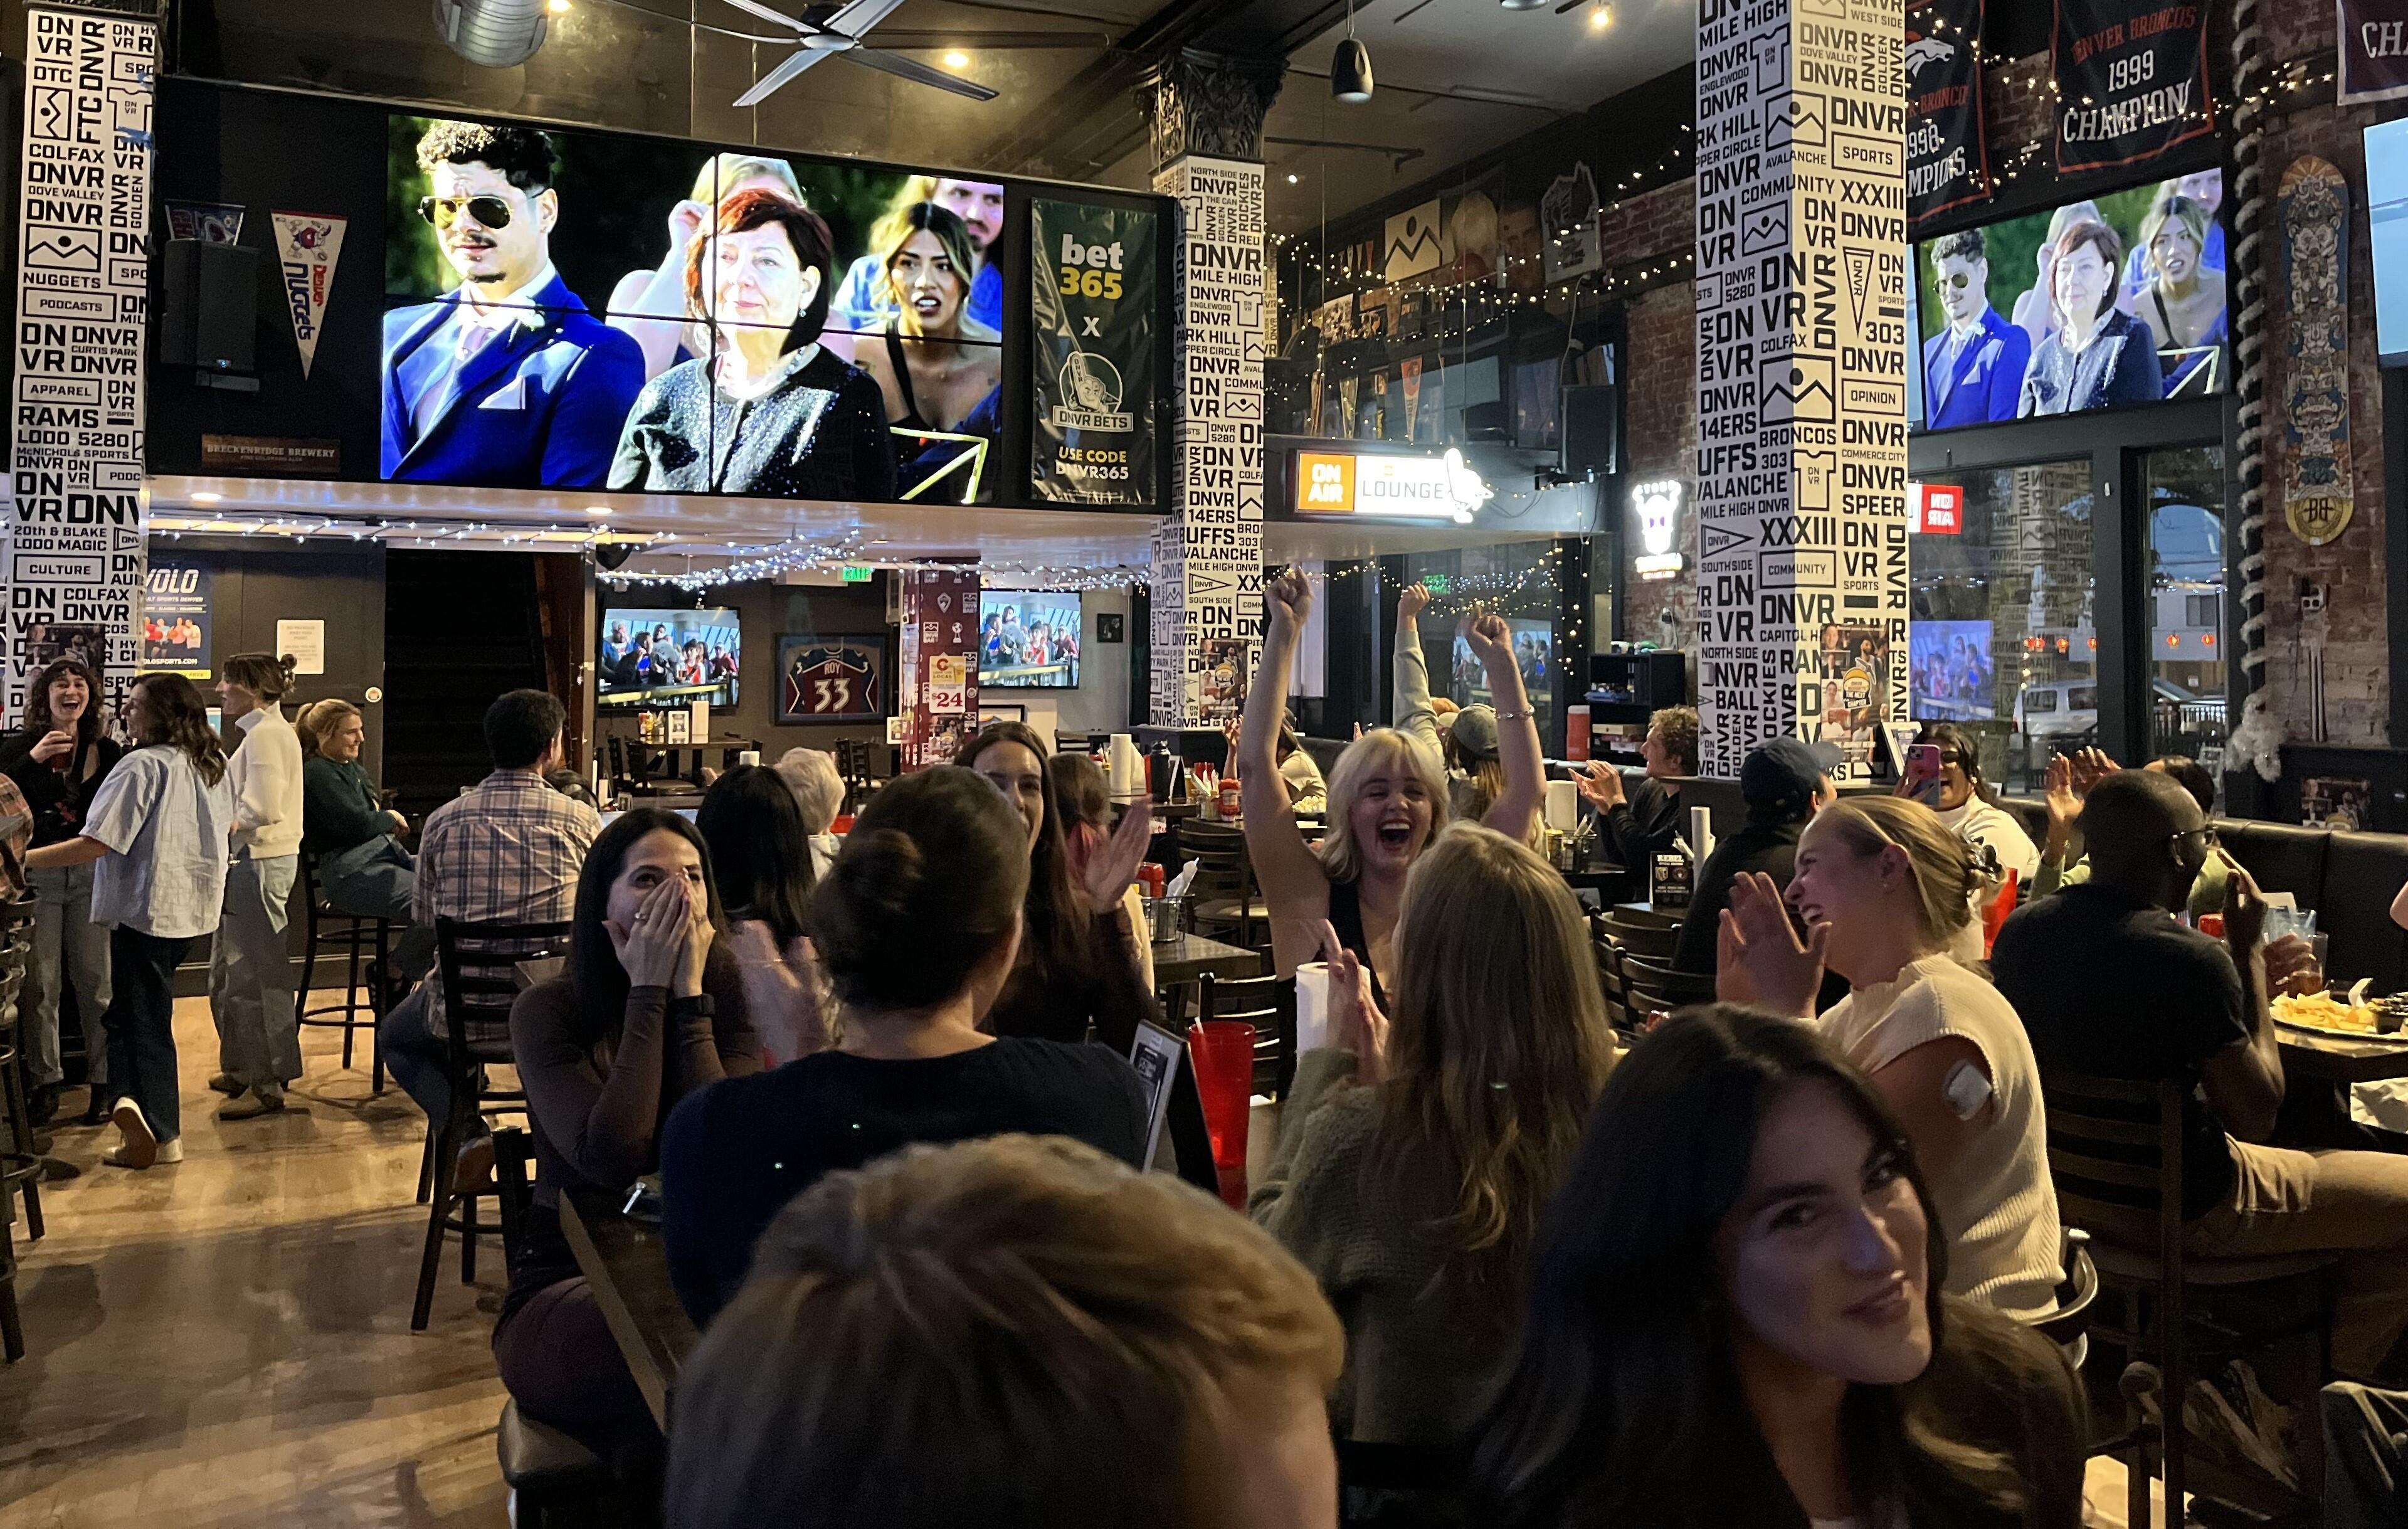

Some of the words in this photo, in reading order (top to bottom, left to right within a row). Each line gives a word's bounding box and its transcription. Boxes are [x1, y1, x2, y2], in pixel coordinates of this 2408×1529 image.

[1700, 16, 1739, 51] MILE
[1745, 0, 1787, 31] HIGH
[1851, 9, 1879, 24] WEST
[1881, 13, 1903, 29] SIDE
[2130, 6, 2196, 40] BRONCOS
[1800, 22, 1857, 52] DNVR
[1700, 38, 1748, 80] DNVR
[1800, 46, 1823, 59] DOVE
[1825, 50, 1857, 64] VALLEY
[1862, 32, 1876, 93] DNVR
[1878, 35, 1888, 94] GOLDEN
[34, 66, 72, 83] DTC
[1800, 60, 1857, 90] DNVR
[1890, 37, 1903, 97] DNVR
[2108, 50, 2154, 92] 1999
[1700, 67, 1749, 95] ENGLEWOOD
[1700, 82, 1748, 120] DNVR
[77, 96, 102, 144] FTC
[1723, 109, 1761, 140] HILL
[1831, 96, 1904, 135] DNVR
[29, 143, 105, 164] COLFAX
[1723, 134, 1761, 159] CIRCLE
[1843, 146, 1893, 166] SPORTS
[1766, 150, 1827, 170] AVALANCHE
[28, 161, 105, 188] DNVR
[1191, 167, 1217, 177] NORTH
[1220, 169, 1237, 179] SIDE
[1701, 153, 1760, 199] DNVR
[28, 185, 59, 198] DOVE
[61, 188, 105, 201] VALLEY
[1191, 176, 1237, 196] DNVR
[1741, 173, 1835, 204] COMMUNITY
[1840, 179, 1904, 210] XXXIII
[131, 176, 144, 229] GOLDEN
[1206, 196, 1220, 204] THE
[1222, 198, 1237, 206] CAN
[1239, 172, 1249, 232] ROCKIES
[26, 198, 103, 226] DNVR
[1842, 211, 1904, 243] DNVR
[1062, 233, 1124, 270] bet
[1190, 243, 1261, 272] DNVR
[23, 272, 101, 288] NUGGETS
[1060, 268, 1122, 300] 365
[1190, 268, 1223, 283] MILE
[1228, 272, 1262, 287] HIGH
[1724, 266, 1755, 287] DNVR
[1191, 286, 1230, 302] DNVR
[1726, 283, 1755, 303] 5280
[1814, 254, 1836, 350] DNVR
[40, 299, 102, 312] PODCASTS
[1190, 302, 1232, 311] ENGLEWOOD
[1191, 310, 1230, 326] DNVR
[71, 325, 138, 346] DNVR
[1210, 331, 1240, 344] HILL
[1866, 322, 1904, 345] 303
[71, 344, 107, 356] CURTIS
[110, 347, 137, 356] PARK
[1210, 347, 1240, 356] CIRCLE
[1700, 315, 1713, 382] DNVR
[1761, 334, 1807, 354] COLFAX
[71, 355, 137, 376] DNVR
[1190, 356, 1240, 375] DNVR
[1842, 346, 1904, 375] DNVR
[30, 384, 92, 396] APPAREL
[1700, 381, 1755, 415] DNVR
[1851, 390, 1896, 405] OPINION
[18, 406, 99, 429] RAMS
[1059, 411, 1090, 427] DNVR
[1094, 413, 1127, 428] BETS
[1699, 411, 1756, 441] 14ERS
[1211, 424, 1235, 433] DNVR
[1211, 434, 1235, 443] 5280
[1760, 426, 1836, 448] BRONCOS
[1842, 419, 1904, 447] DNVR
[18, 430, 70, 445] LODO
[78, 431, 130, 448] 5280
[84, 449, 130, 460] SPORTS
[208, 445, 284, 455] BRECKENRIDGE
[288, 448, 335, 457] BREWERY
[1059, 446, 1083, 461] USE
[1086, 448, 1126, 463] CODE
[1698, 442, 1756, 476] UFFS
[1761, 452, 1787, 469] 303
[1842, 449, 1886, 461] COMMERCE
[1888, 452, 1905, 462] CITY
[1055, 459, 1129, 480] DNVR365
[1312, 463, 1341, 483] ON
[1842, 463, 1905, 491] DNVR
[1190, 490, 1234, 507] DNVR
[1308, 484, 1344, 502] AIR
[1363, 480, 1444, 499] LOUNGE
[1700, 502, 1725, 519] MILE
[1728, 500, 1755, 517] HIGH
[1758, 498, 1789, 514] DNVR
[1842, 494, 1905, 517] SPEER
[1189, 509, 1235, 523] 14ERS
[14, 526, 45, 536] 20th
[50, 526, 59, 537] &
[63, 527, 107, 537] BLAKE
[1179, 526, 1235, 545] BUFFS
[1239, 537, 1258, 546] 303
[1708, 535, 1729, 546] DNVR
[1760, 516, 1836, 547] XXXIII
[14, 539, 55, 550] LODO
[58, 539, 107, 551] MAGIC
[1179, 546, 1258, 561] AVALANCHE
[29, 564, 91, 575] CULTURE
[1189, 563, 1210, 571] MILE
[1213, 563, 1233, 571] HIGH
[1236, 564, 1259, 572] DNVR
[1701, 560, 1731, 573] SOUTH
[1732, 559, 1753, 571] SIDE
[1768, 564, 1826, 576] COMMUNITY
[1887, 524, 1906, 610] DNVR
[64, 588, 129, 601] COLFAX
[1844, 580, 1879, 591] SPORTS
[63, 604, 129, 621] DNVR
[1760, 594, 1834, 625] DNVR
[1760, 630, 1806, 643] CAPITOL
[1702, 647, 1733, 659] NORTH
[1735, 647, 1758, 659] SIDE
[824, 662, 840, 675] ROY
[815, 678, 850, 713] 33
[932, 692, 963, 707] $24
[1716, 690, 1758, 711] BALL
